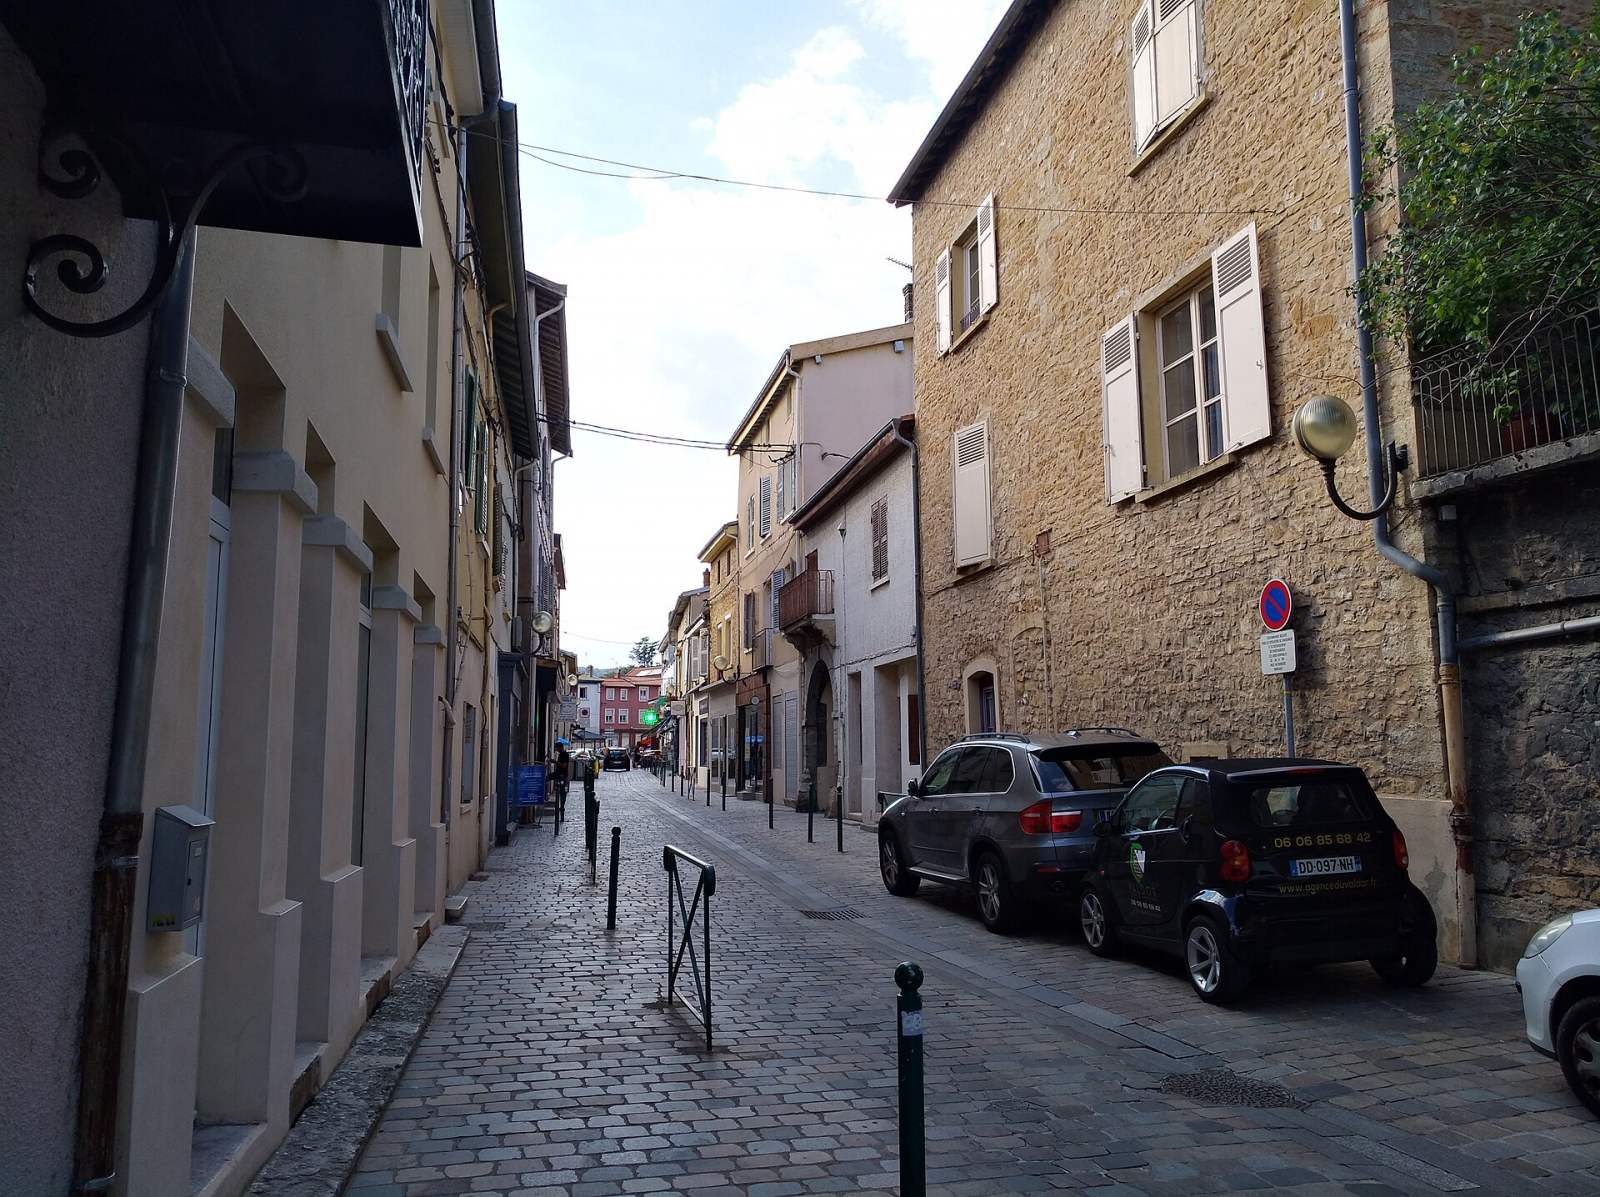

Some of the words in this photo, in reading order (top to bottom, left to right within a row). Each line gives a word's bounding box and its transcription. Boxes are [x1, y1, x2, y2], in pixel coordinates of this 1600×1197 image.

[1273, 837, 1292, 848] 06
[1295, 836, 1313, 847] 06
[1316, 834, 1333, 846] 85
[1357, 831, 1372, 843] 42
[1298, 857, 1354, 874] DD-097-NH
